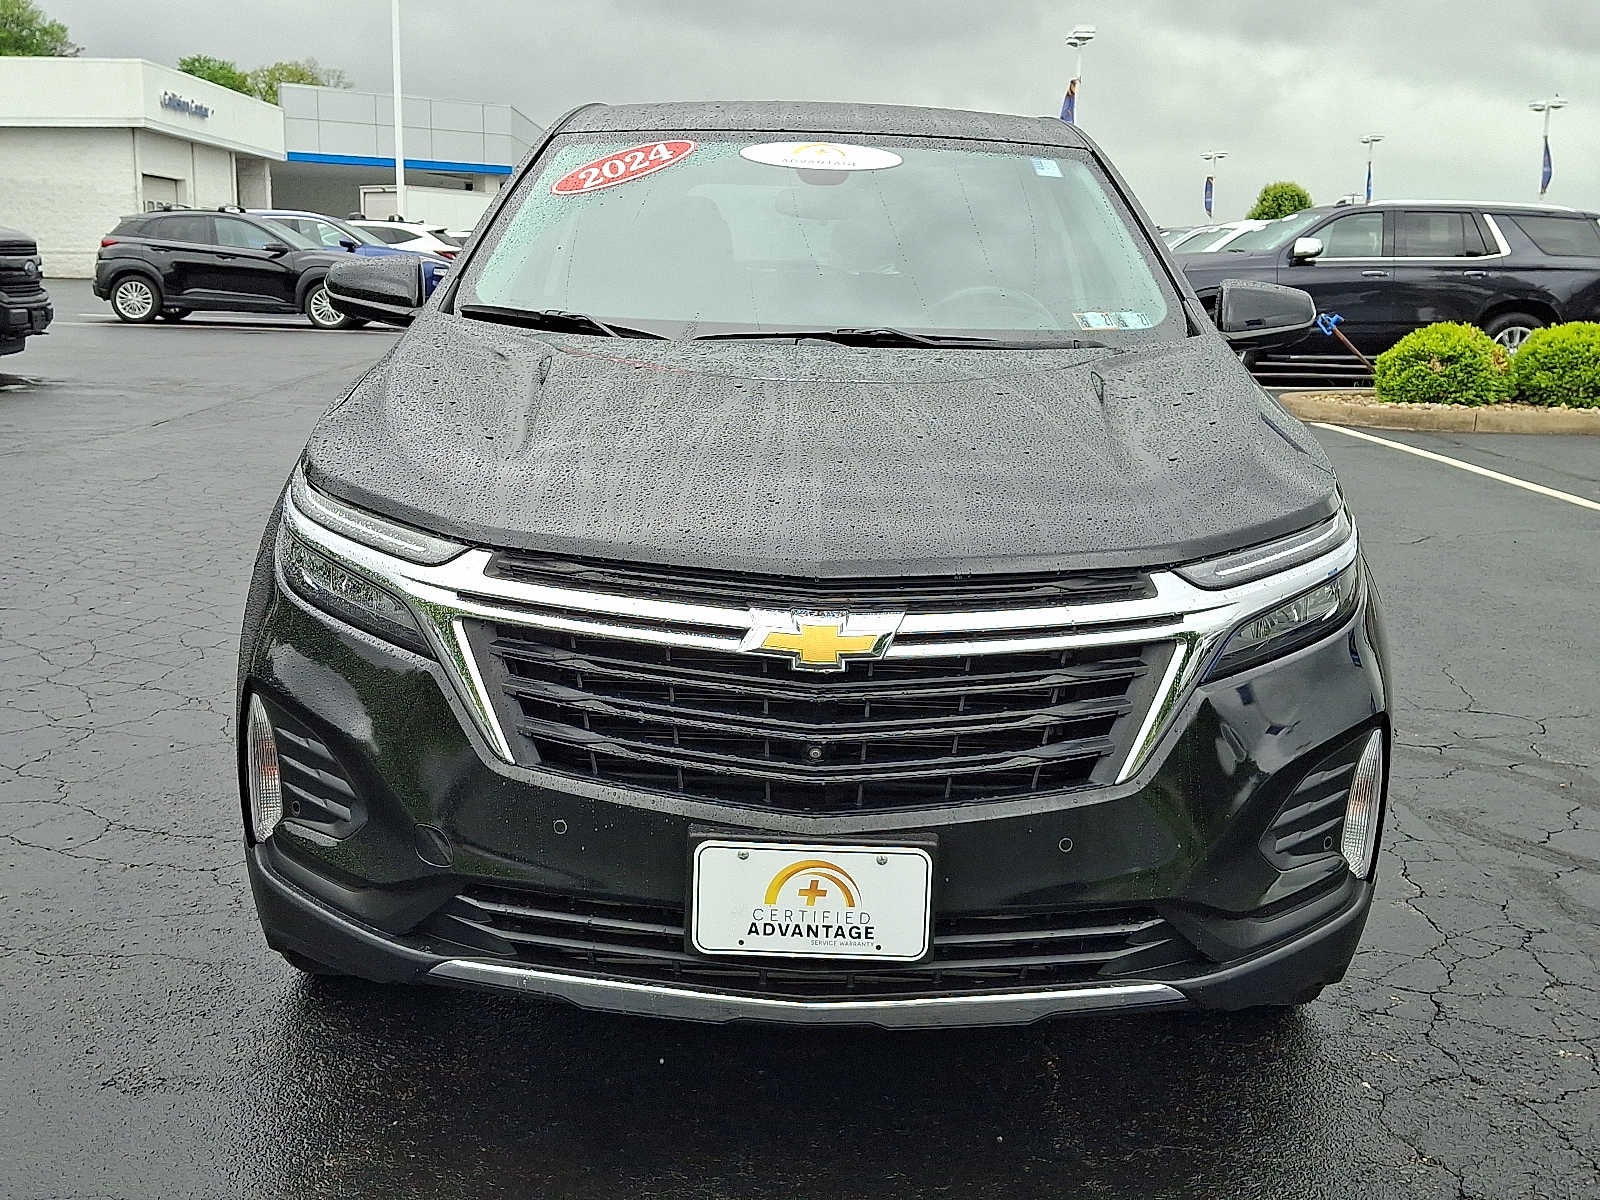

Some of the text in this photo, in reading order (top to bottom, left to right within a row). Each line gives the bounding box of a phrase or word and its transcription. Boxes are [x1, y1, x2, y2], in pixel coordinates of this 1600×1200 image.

[578, 143, 674, 189] 2024
[752, 908, 871, 925] CERTIFIED
[747, 921, 875, 940] ADVANTAGE
